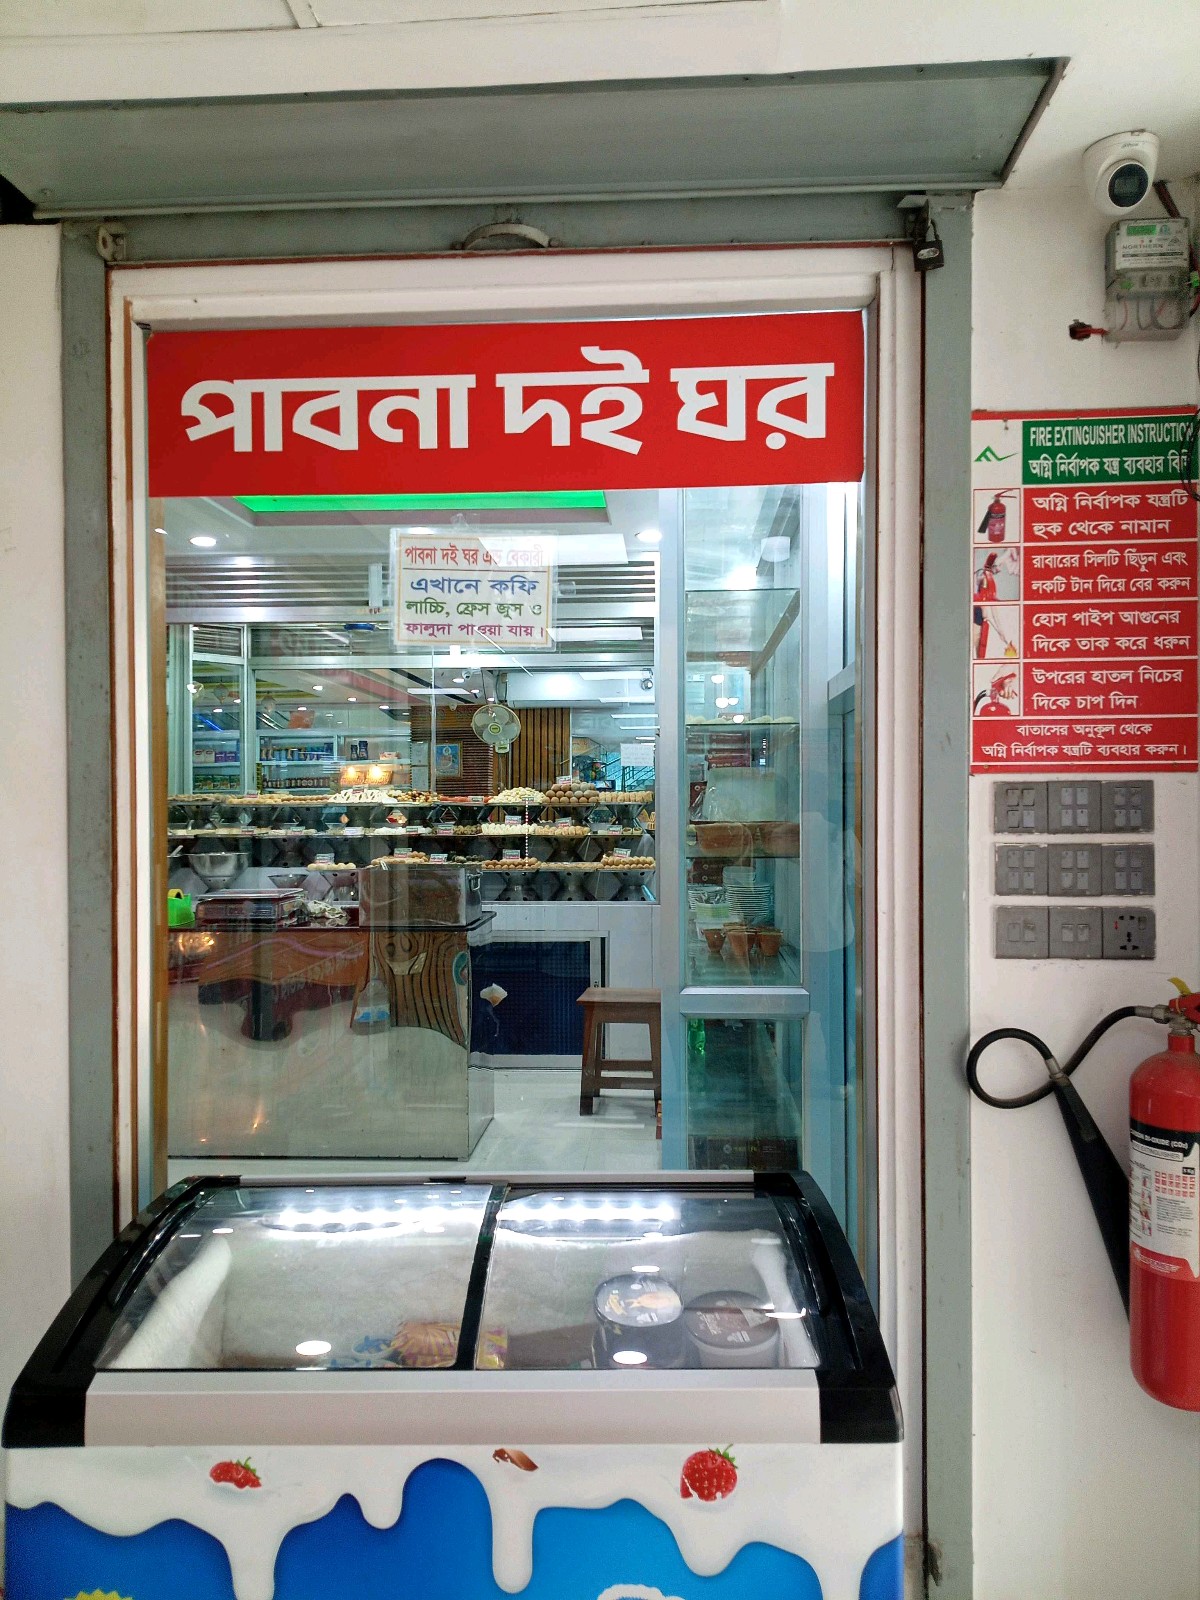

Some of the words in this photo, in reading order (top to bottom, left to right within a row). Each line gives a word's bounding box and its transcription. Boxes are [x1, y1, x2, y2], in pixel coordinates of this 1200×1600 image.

[180, 373, 476, 453] পাবনা
[495, 346, 649, 455] দই
[670, 362, 834, 450] ঘর
[1030, 426, 1052, 447] FIRE
[1054, 423, 1126, 446] EXTINGUISHER
[1028, 453, 1053, 479] অগ্নি
[1056, 452, 1100, 477] নির্বাপক
[1103, 456, 1120, 476] যন্ত্র
[1122, 455, 1165, 475] ব্যবহার
[1032, 492, 1069, 512] অগ্নি
[1073, 491, 1141, 510] নির্বাপক
[1148, 489, 1189, 508] যন্ত্রটি
[1032, 522, 1063, 539] হুক
[1068, 520, 1114, 536] থেকে
[1120, 519, 1171, 534] নামান
[405, 546, 437, 566] পাবনা
[441, 543, 459, 567] দই
[462, 548, 479, 567] ঘর
[1032, 554, 1080, 569] রাবারের
[1083, 549, 1121, 567] সিলটি
[1162, 551, 1189, 566] এবং
[411, 576, 482, 594] এখানে
[488, 574, 540, 595] কফি
[1032, 575, 1067, 594] লকটি
[1070, 575, 1092, 593] টান
[1097, 575, 1126, 592] দিয়ে
[1130, 577, 1153, 591] বের
[1157, 576, 1191, 590] করুন
[456, 601, 491, 618] ফ্রেস
[496, 602, 524, 620] জুস
[530, 604, 542, 616] ও
[1032, 612, 1067, 627] হোস
[1072, 608, 1115, 626] পাইপ
[1119, 610, 1181, 625] আগুনের
[404, 622, 453, 638] ফালুদা
[1032, 635, 1071, 652] দিকে
[1075, 637, 1110, 652] তাক
[1115, 636, 1148, 651] করে
[1153, 635, 1191, 649] ধরুন
[1032, 667, 1086, 685] উপরের
[1090, 670, 1133, 684] হাতল
[1138, 665, 1183, 683] নিচের
[1032, 693, 1071, 710] দিকে
[1075, 694, 1104, 710] চাপ
[1109, 691, 1138, 709] দিন
[1016, 724, 1069, 737] বাতাসের
[1072, 723, 1116, 739] অনুকূল
[1120, 723, 1153, 736] থেকে
[981, 743, 1007, 759] অগ্নি
[1010, 742, 1059, 757] নির্বাপক
[1062, 741, 1094, 757] যন্ত্রটি
[1097, 744, 1140, 757] ব্যবহার
